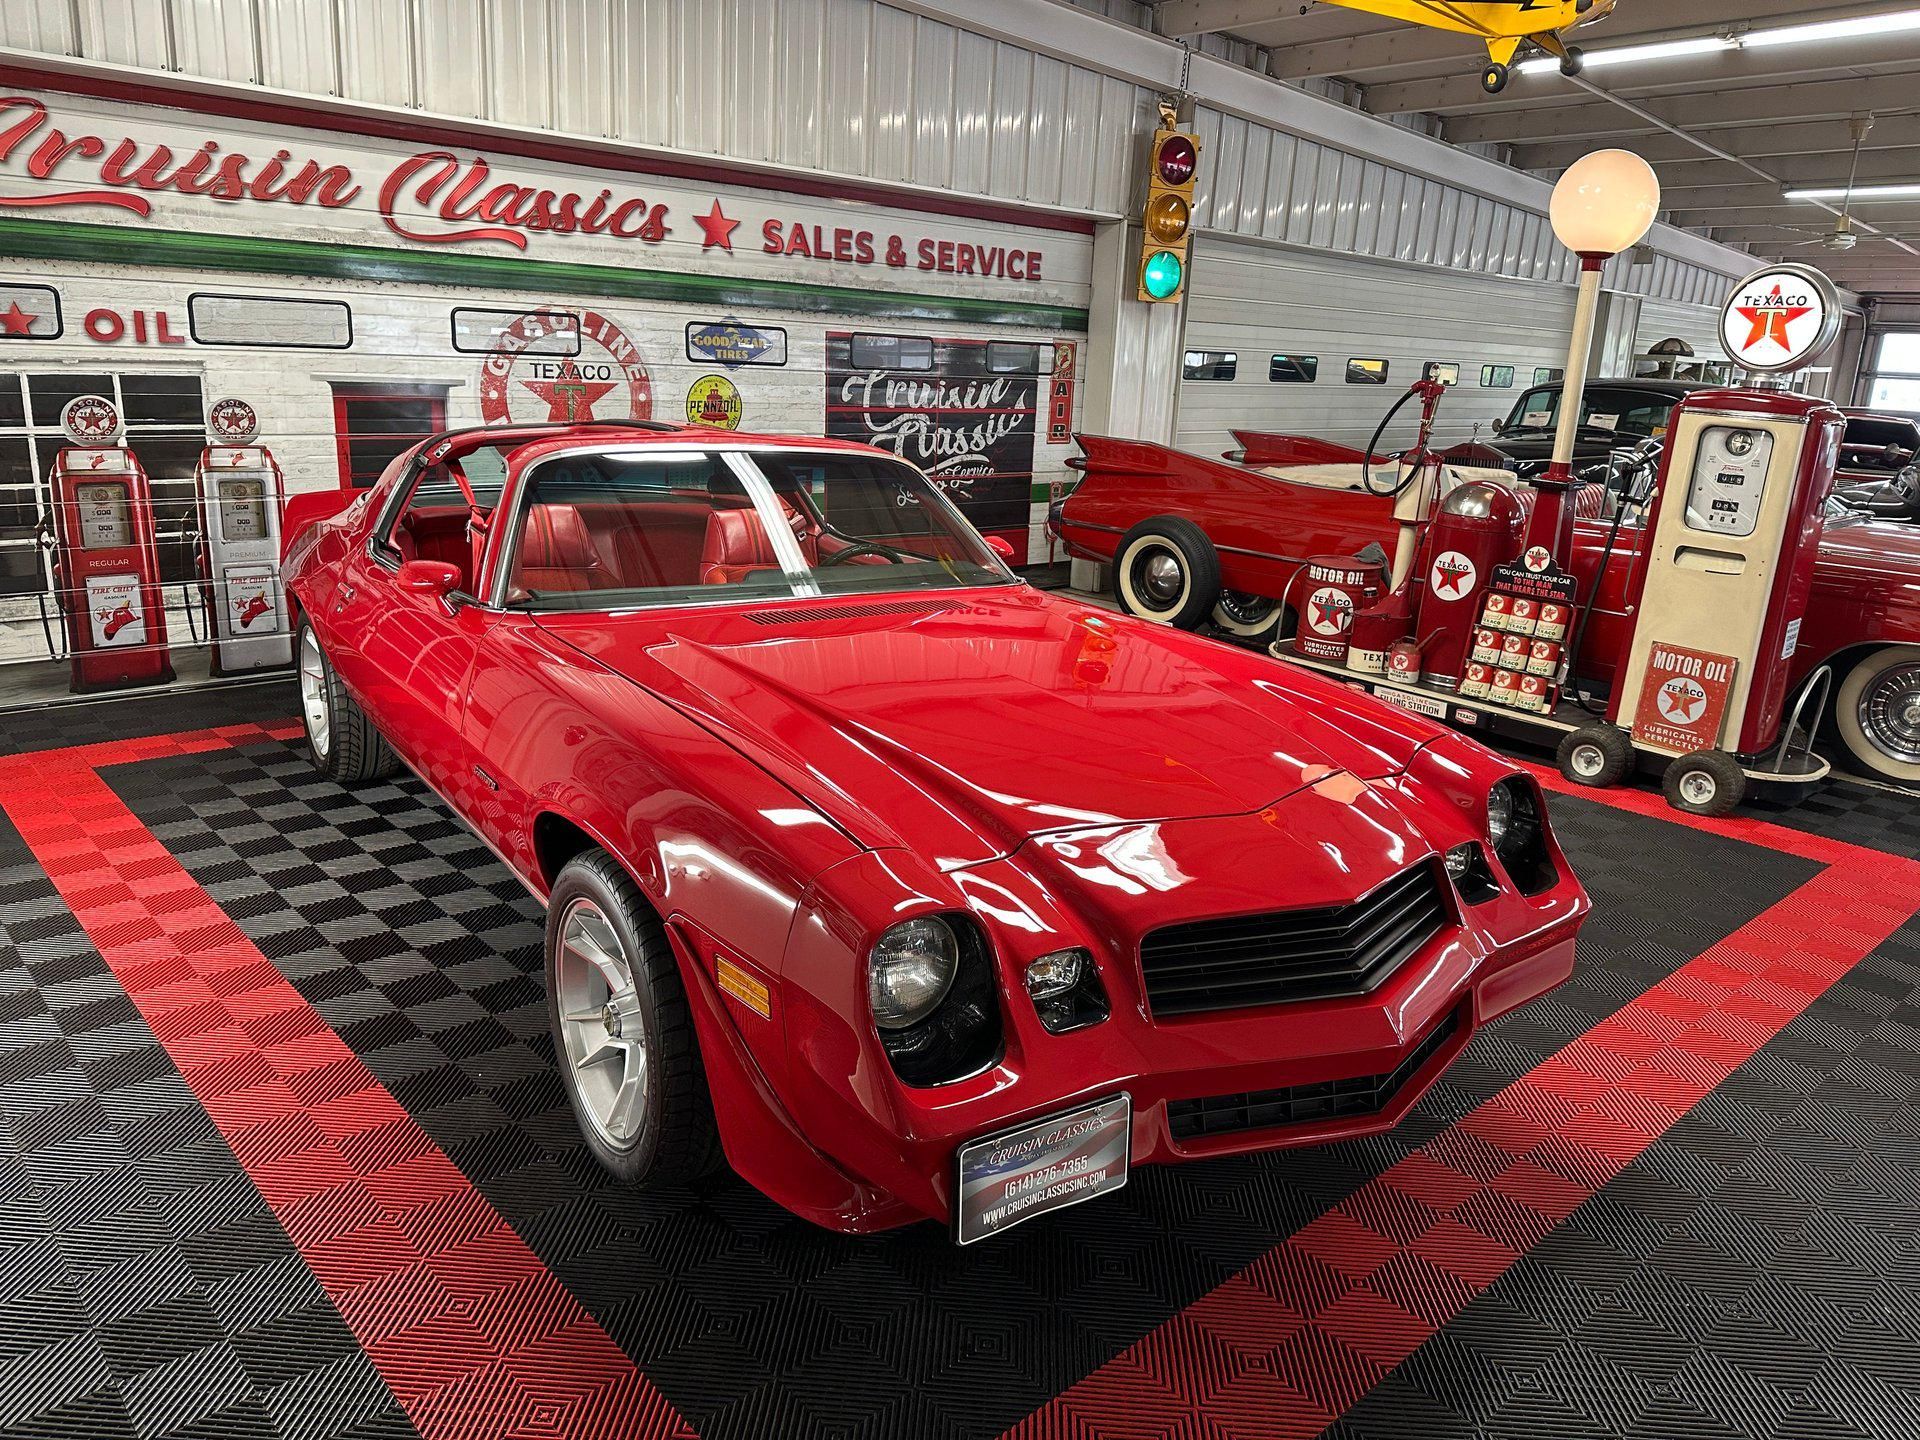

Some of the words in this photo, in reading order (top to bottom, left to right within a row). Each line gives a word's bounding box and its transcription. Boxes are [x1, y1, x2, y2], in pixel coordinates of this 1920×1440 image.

[379, 151, 672, 250] Classics
[762, 219, 874, 264] SALES
[885, 235, 906, 267] &
[918, 239, 1042, 281] SERVICE
[1744, 294, 1807, 306] TEXACO
[84, 308, 187, 344] OIL
[487, 306, 648, 385] GASOLINE
[716, 349, 748, 359] TIRES
[530, 362, 612, 381] TEXACO
[69, 400, 115, 417] GASOLINE
[212, 400, 254, 417] GASOLINE
[690, 400, 738, 413] PENNZOIL
[1053, 381, 1069, 438] AIR
[89, 558, 130, 568] REGULAR
[1438, 560, 1469, 571] TEXACO
[1309, 565, 1345, 584] MOTOR
[1347, 571, 1364, 585] OIL
[1499, 568, 1511, 576] YOU
[1542, 574, 1558, 583] YOUR
[1496, 581, 1511, 590] THAT
[1512, 584, 1535, 594] WEARS
[1536, 588, 1548, 596] THE
[1522, 578, 1534, 586] THE
[1536, 581, 1552, 589] MAN
[1313, 594, 1351, 606] TEXACO
[1304, 641, 1345, 652] LUBRICATES
[1304, 646, 1342, 657] PERFECTLY
[1653, 651, 1700, 677] MOTOR
[1704, 661, 1727, 683] OIL
[1391, 692, 1428, 705] GASOLINE
[1666, 683, 1704, 698] TEXACO
[1408, 701, 1439, 715] STATION
[1457, 712, 1476, 721] TEXACO
[1643, 724, 1704, 744] LUBRICATES
[1644, 733, 1700, 751] PERFECTLY
[990, 1136, 1044, 1165] CRUISIN
[1047, 1116, 1106, 1145] CLASSICS
[1004, 1173, 1034, 1199] (614)
[1036, 1155, 1088, 1186] 276-7355
[982, 1170, 1106, 1225] WWW.CRUISINCLASSICSINC.COM
